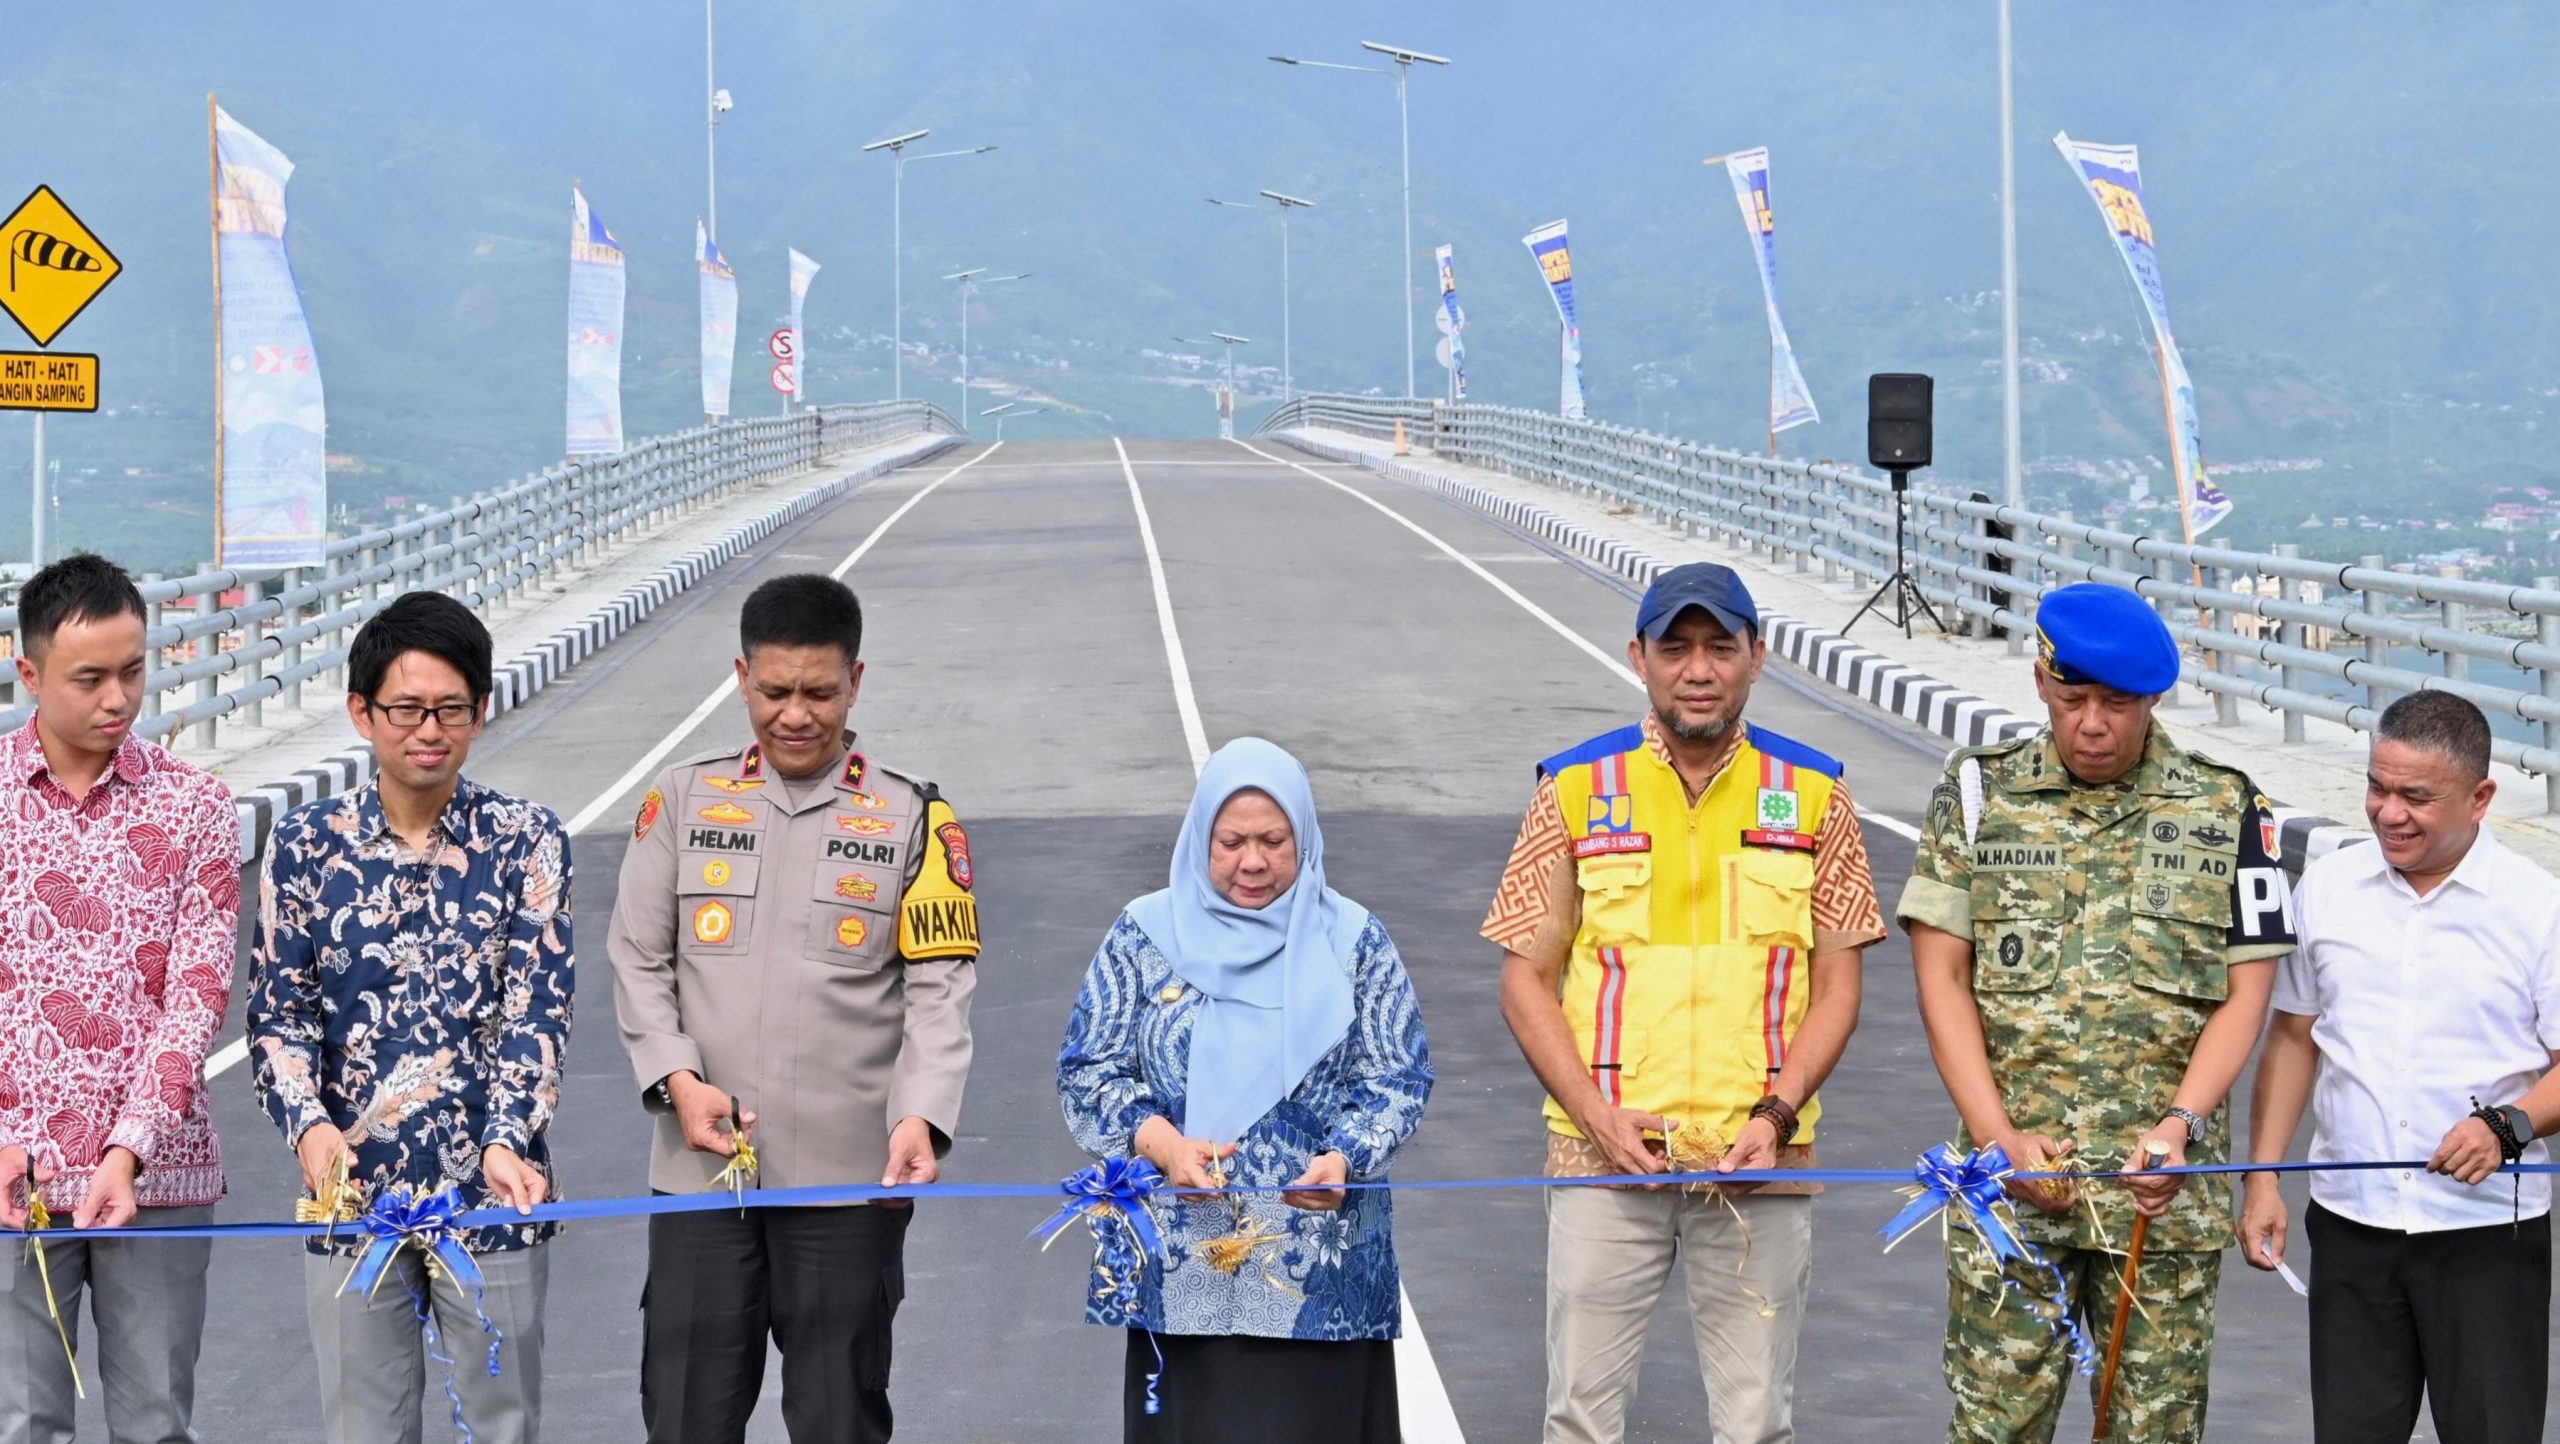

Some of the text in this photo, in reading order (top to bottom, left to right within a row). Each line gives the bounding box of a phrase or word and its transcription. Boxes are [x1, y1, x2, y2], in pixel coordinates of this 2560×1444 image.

[5, 360, 36, 379] HATI
[48, 361, 79, 382] HATI
[36, 383, 85, 403] SAMPING
[688, 829, 756, 851] HELMI
[1611, 837, 1617, 848] S
[1619, 835, 1644, 848] RAZAK
[827, 839, 895, 864] POLRI
[1977, 849, 2056, 866] M.HADIAN
[2151, 853, 2227, 876] TNI AD
